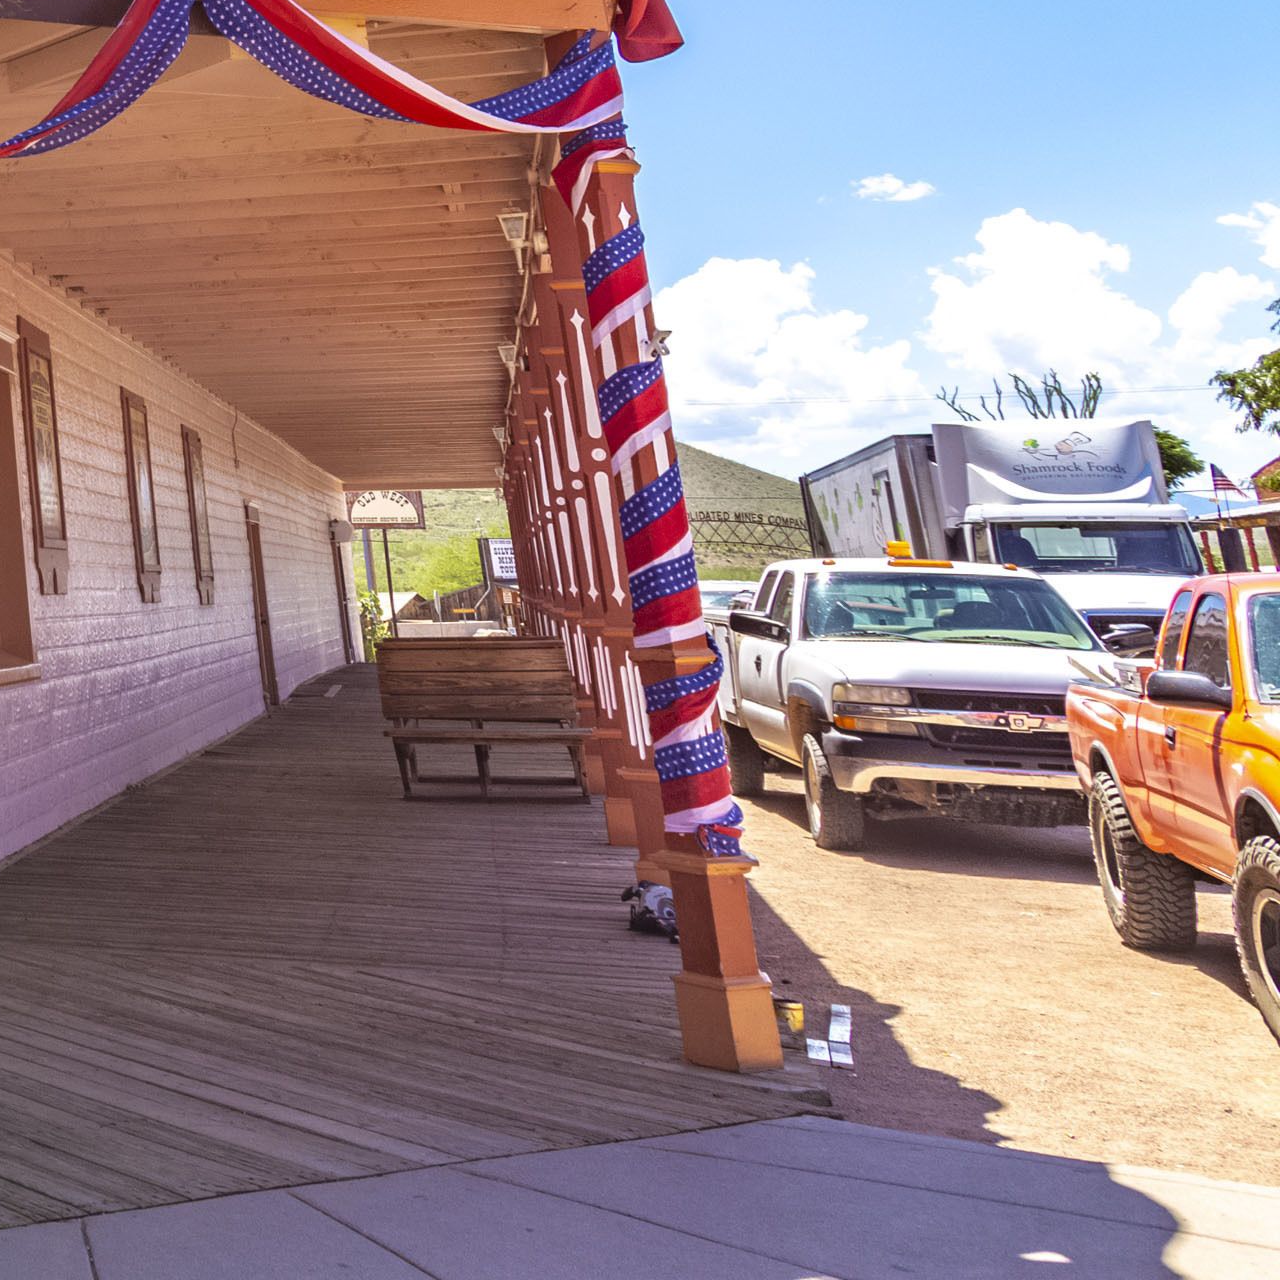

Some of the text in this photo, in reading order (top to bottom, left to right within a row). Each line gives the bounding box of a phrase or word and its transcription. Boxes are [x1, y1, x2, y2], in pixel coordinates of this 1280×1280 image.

[1012, 461, 1127, 476] Shamrock Foods
[357, 490, 409, 508] OLD WEST
[687, 510, 729, 521] LIDATED
[734, 512, 763, 523] MINES
